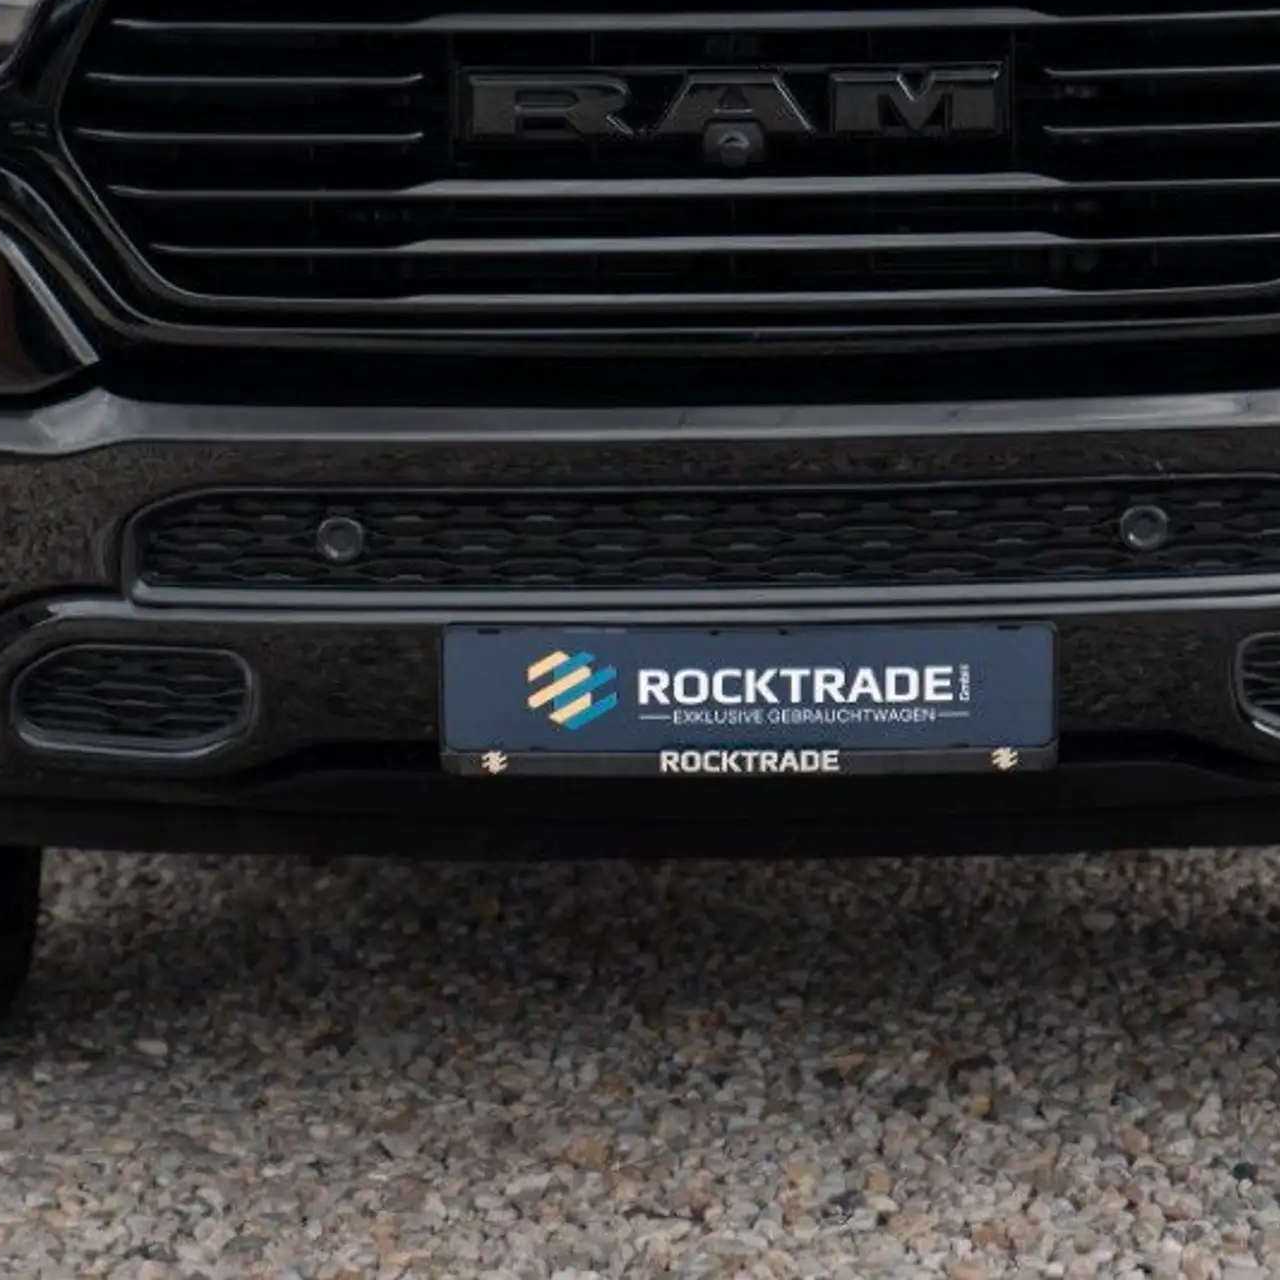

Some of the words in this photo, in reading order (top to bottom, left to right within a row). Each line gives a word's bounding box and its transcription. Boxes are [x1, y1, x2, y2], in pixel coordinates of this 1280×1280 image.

[467, 65, 1004, 138] RAM
[637, 666, 954, 706] ROCKTRADE
[672, 707, 765, 726] EXKLUSIVE
[767, 706, 937, 725] GEBRAUCHTWAGEN
[660, 748, 841, 774] ROCKTRADE
